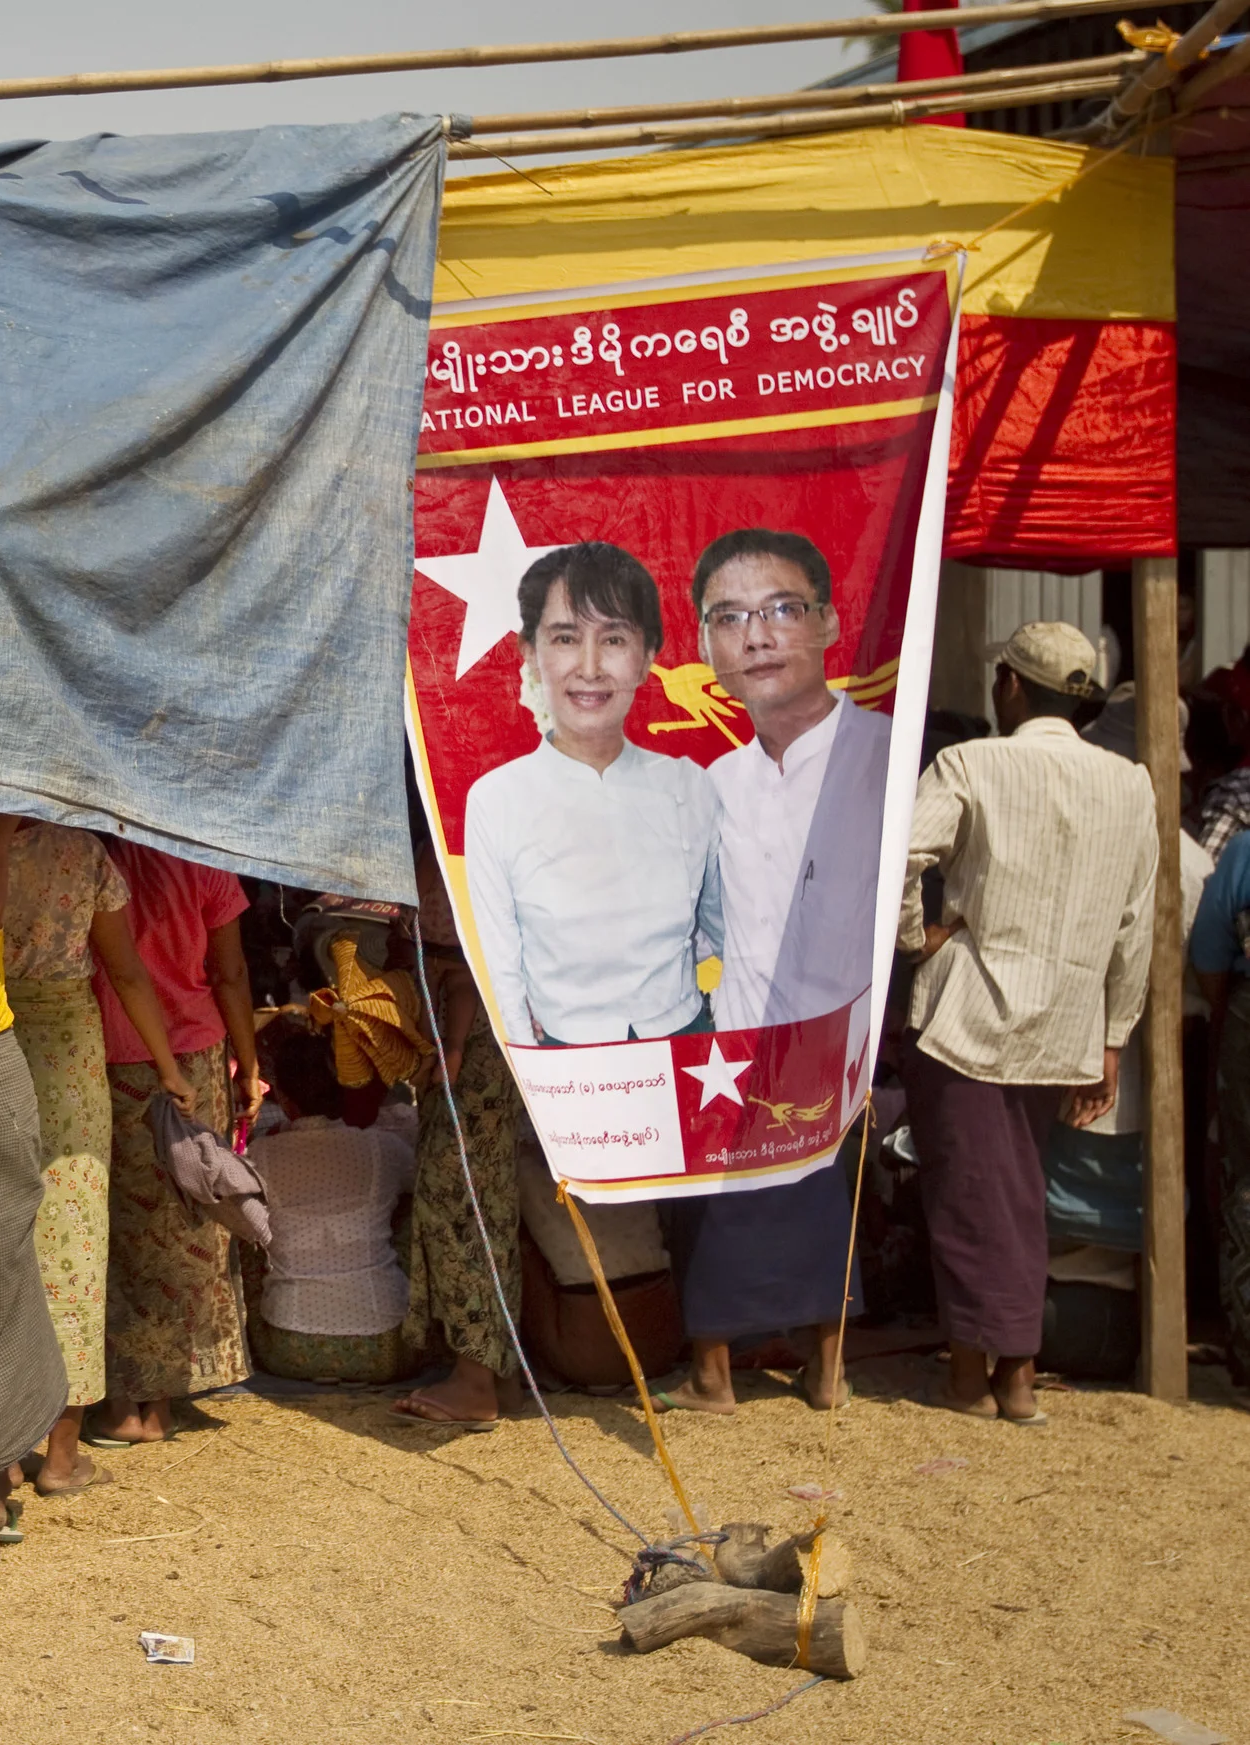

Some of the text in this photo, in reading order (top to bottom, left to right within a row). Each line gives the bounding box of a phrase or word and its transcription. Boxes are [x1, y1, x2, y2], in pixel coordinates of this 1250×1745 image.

[419, 355, 926, 433] ATIONAL LEAGUE FOR DEMOCRACY
